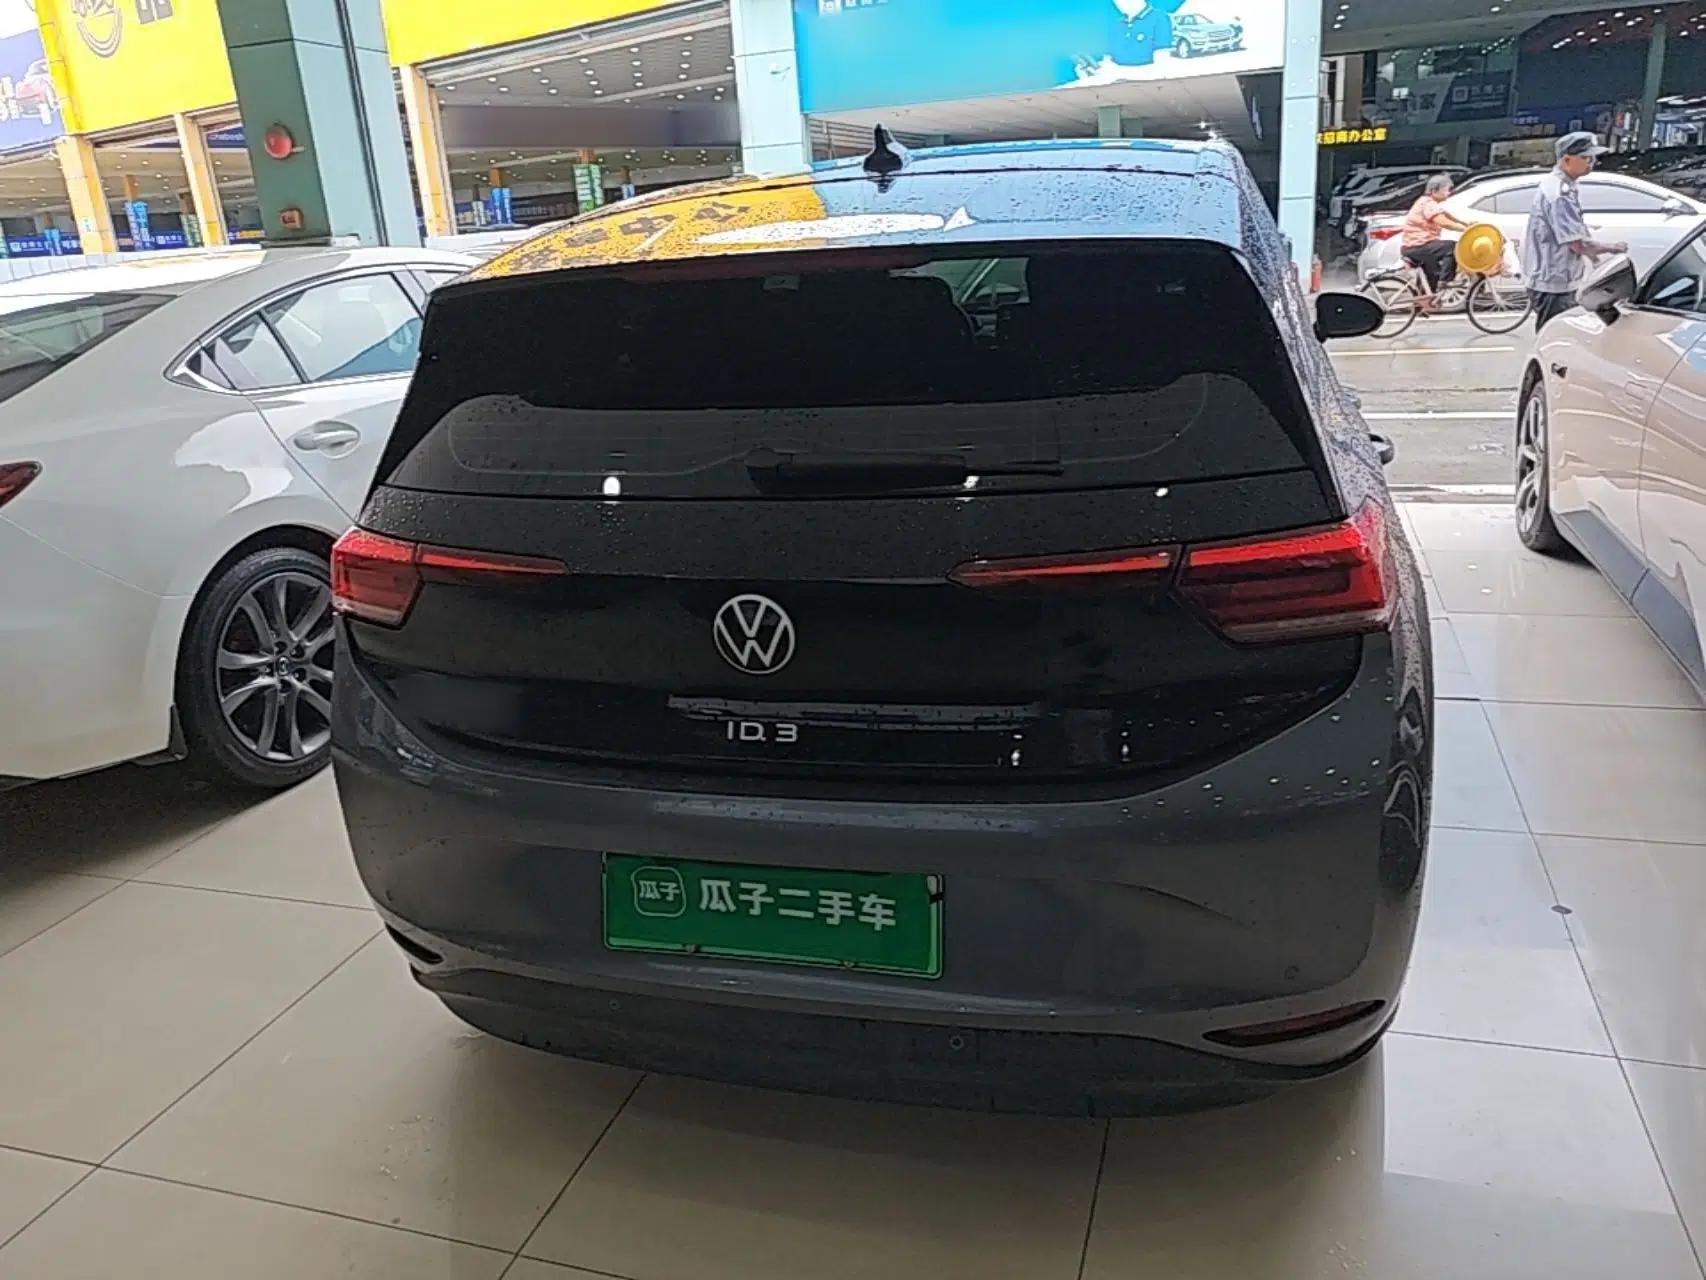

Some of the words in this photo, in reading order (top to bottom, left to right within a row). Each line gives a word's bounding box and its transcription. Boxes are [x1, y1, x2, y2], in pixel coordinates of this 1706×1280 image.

[714, 594, 795, 674] VW
[639, 880, 682, 901] 瓜子
[700, 879, 896, 931] 瓜子二手车
